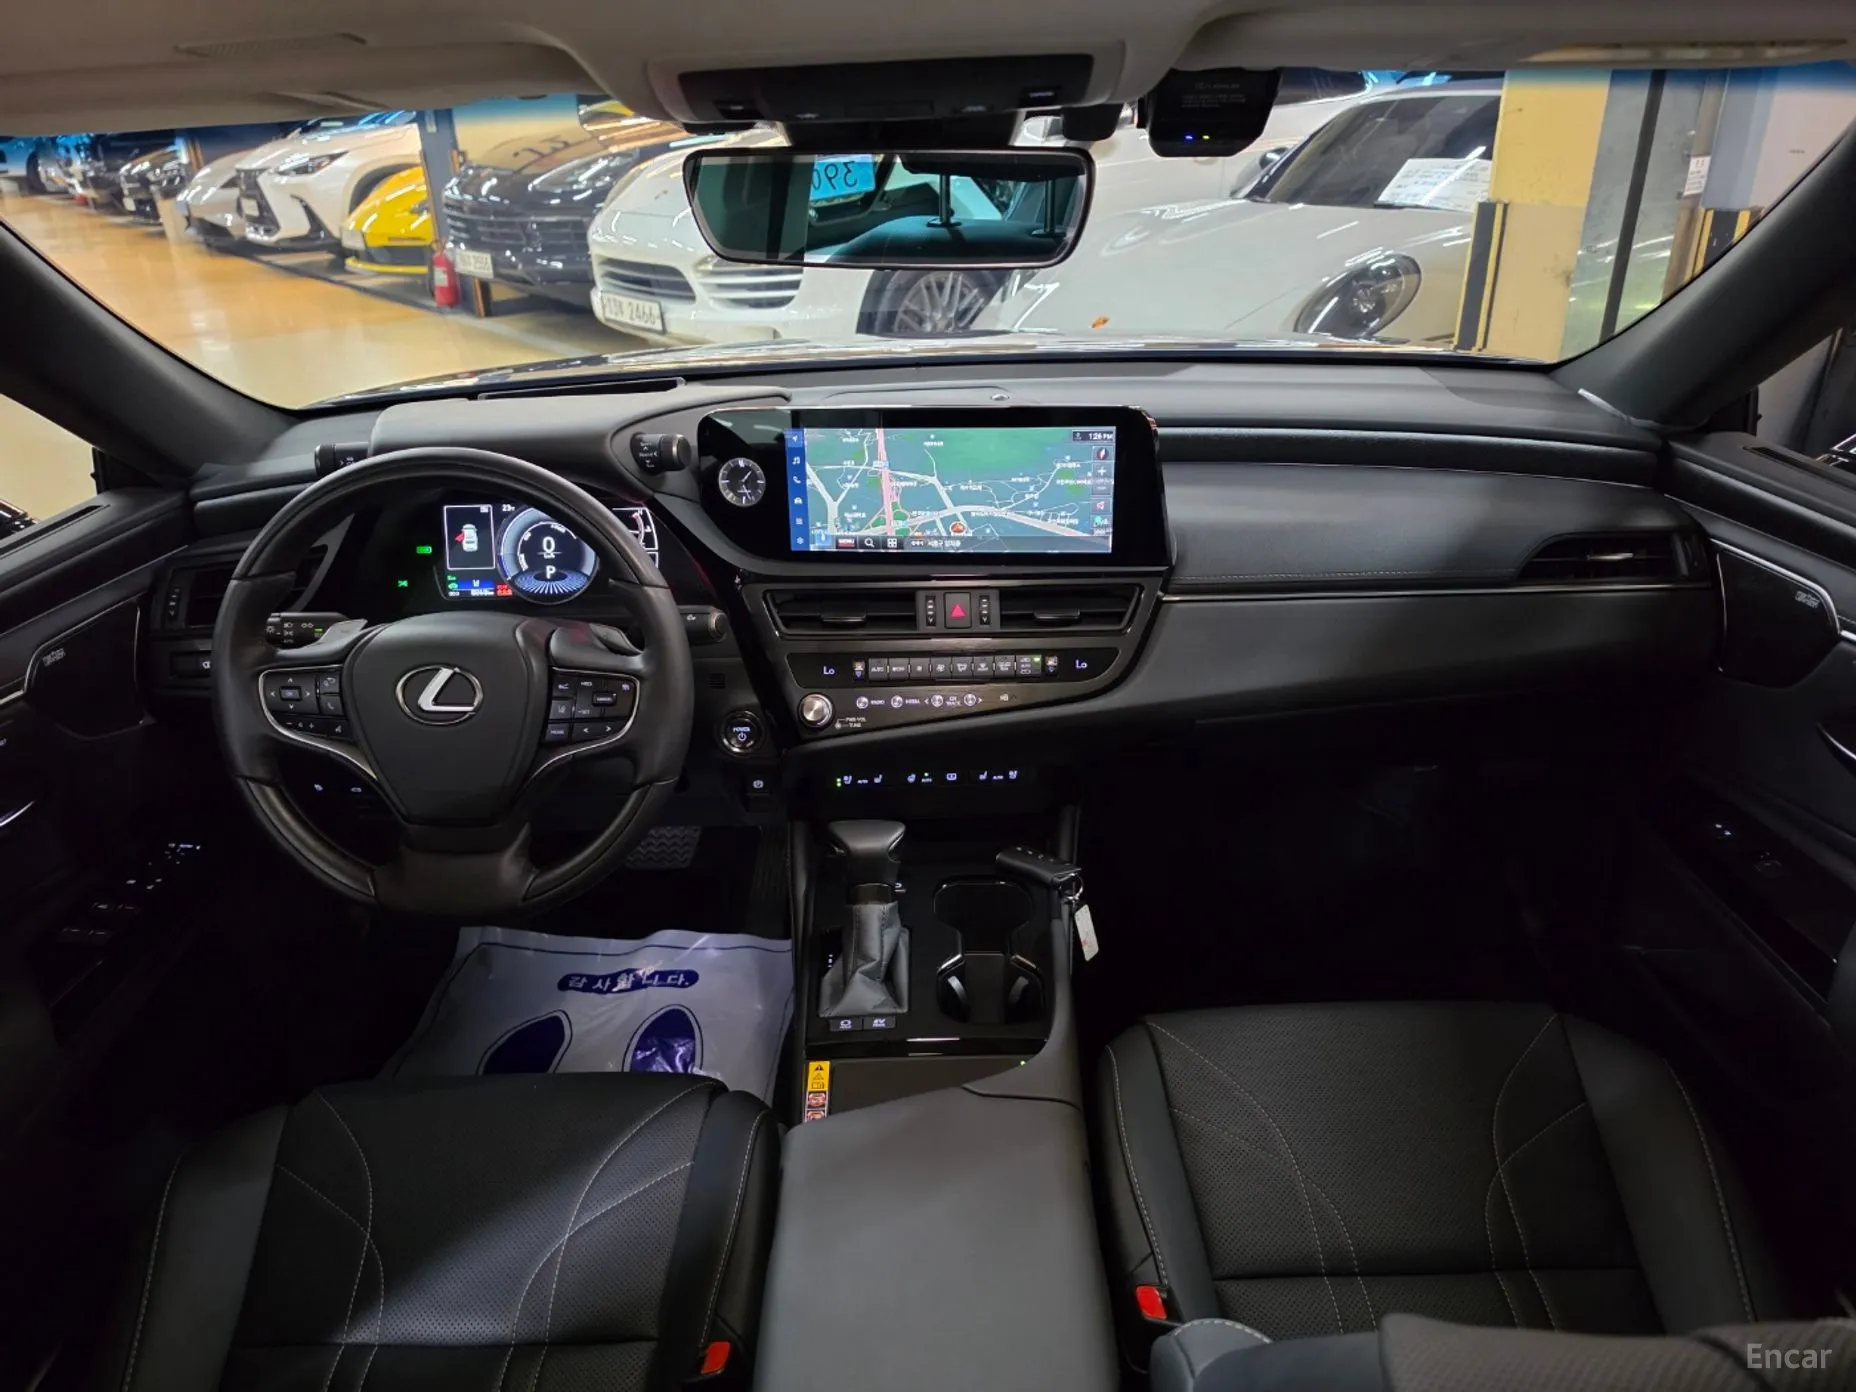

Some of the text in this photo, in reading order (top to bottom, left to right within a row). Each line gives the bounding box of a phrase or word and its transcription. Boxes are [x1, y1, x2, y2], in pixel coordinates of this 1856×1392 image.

[542, 536, 556, 553] 0
[545, 565, 556, 579] P
[1075, 659, 1088, 669] Lo
[823, 666, 835, 675] Lo
